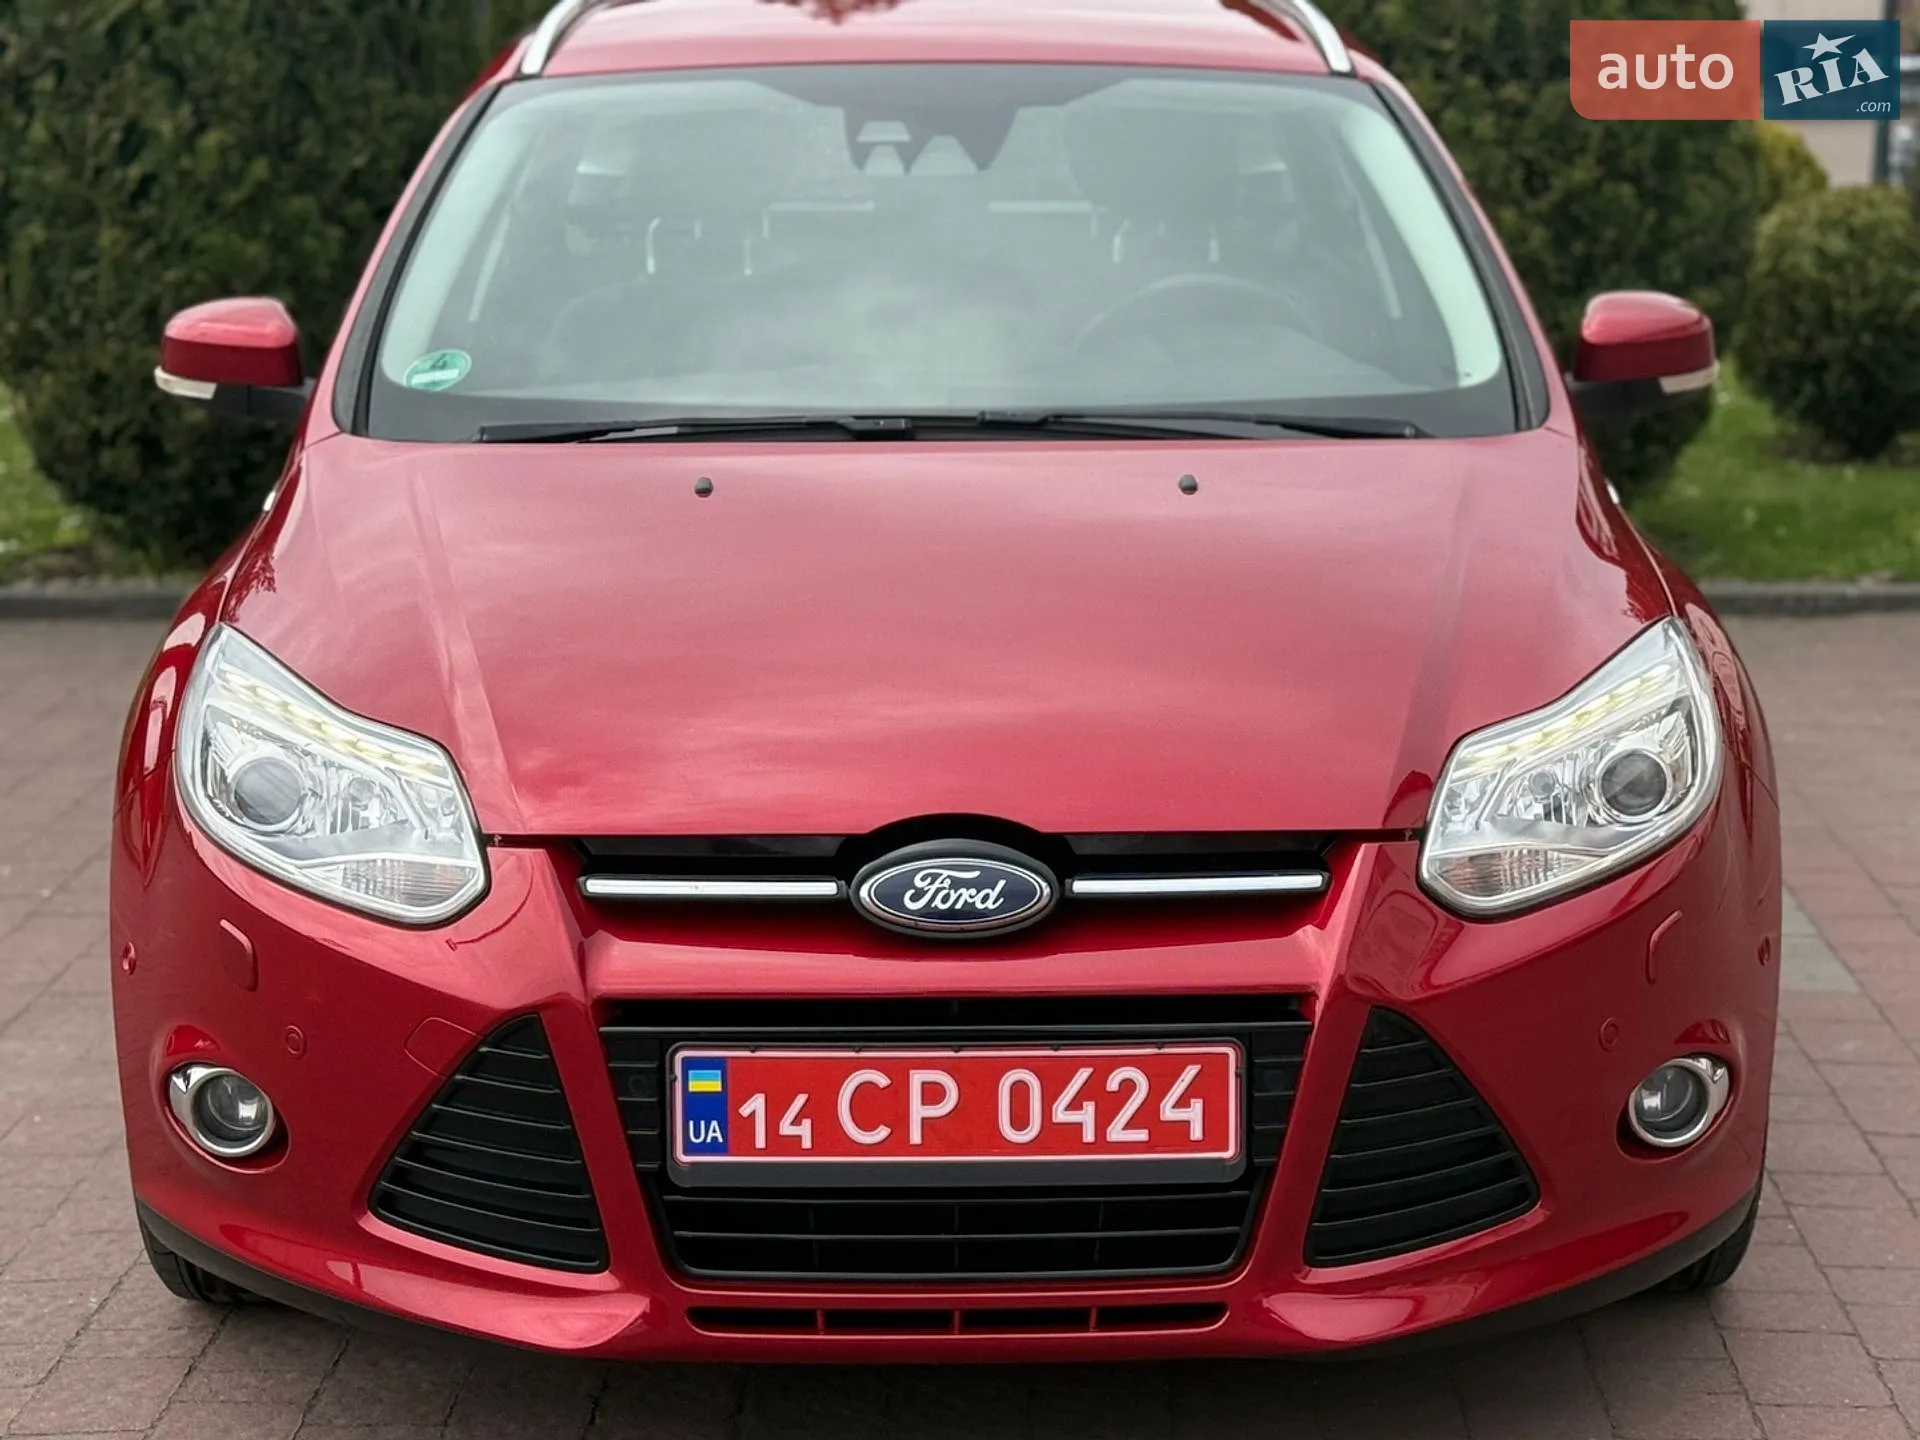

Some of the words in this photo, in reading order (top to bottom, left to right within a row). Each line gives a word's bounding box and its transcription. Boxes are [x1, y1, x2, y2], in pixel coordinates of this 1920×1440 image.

[903, 868, 1007, 910] Ford
[738, 1092, 813, 1149] 14
[837, 1069, 960, 1145] CP
[998, 1064, 1204, 1145] 0424
[688, 1119, 724, 1144] UA
